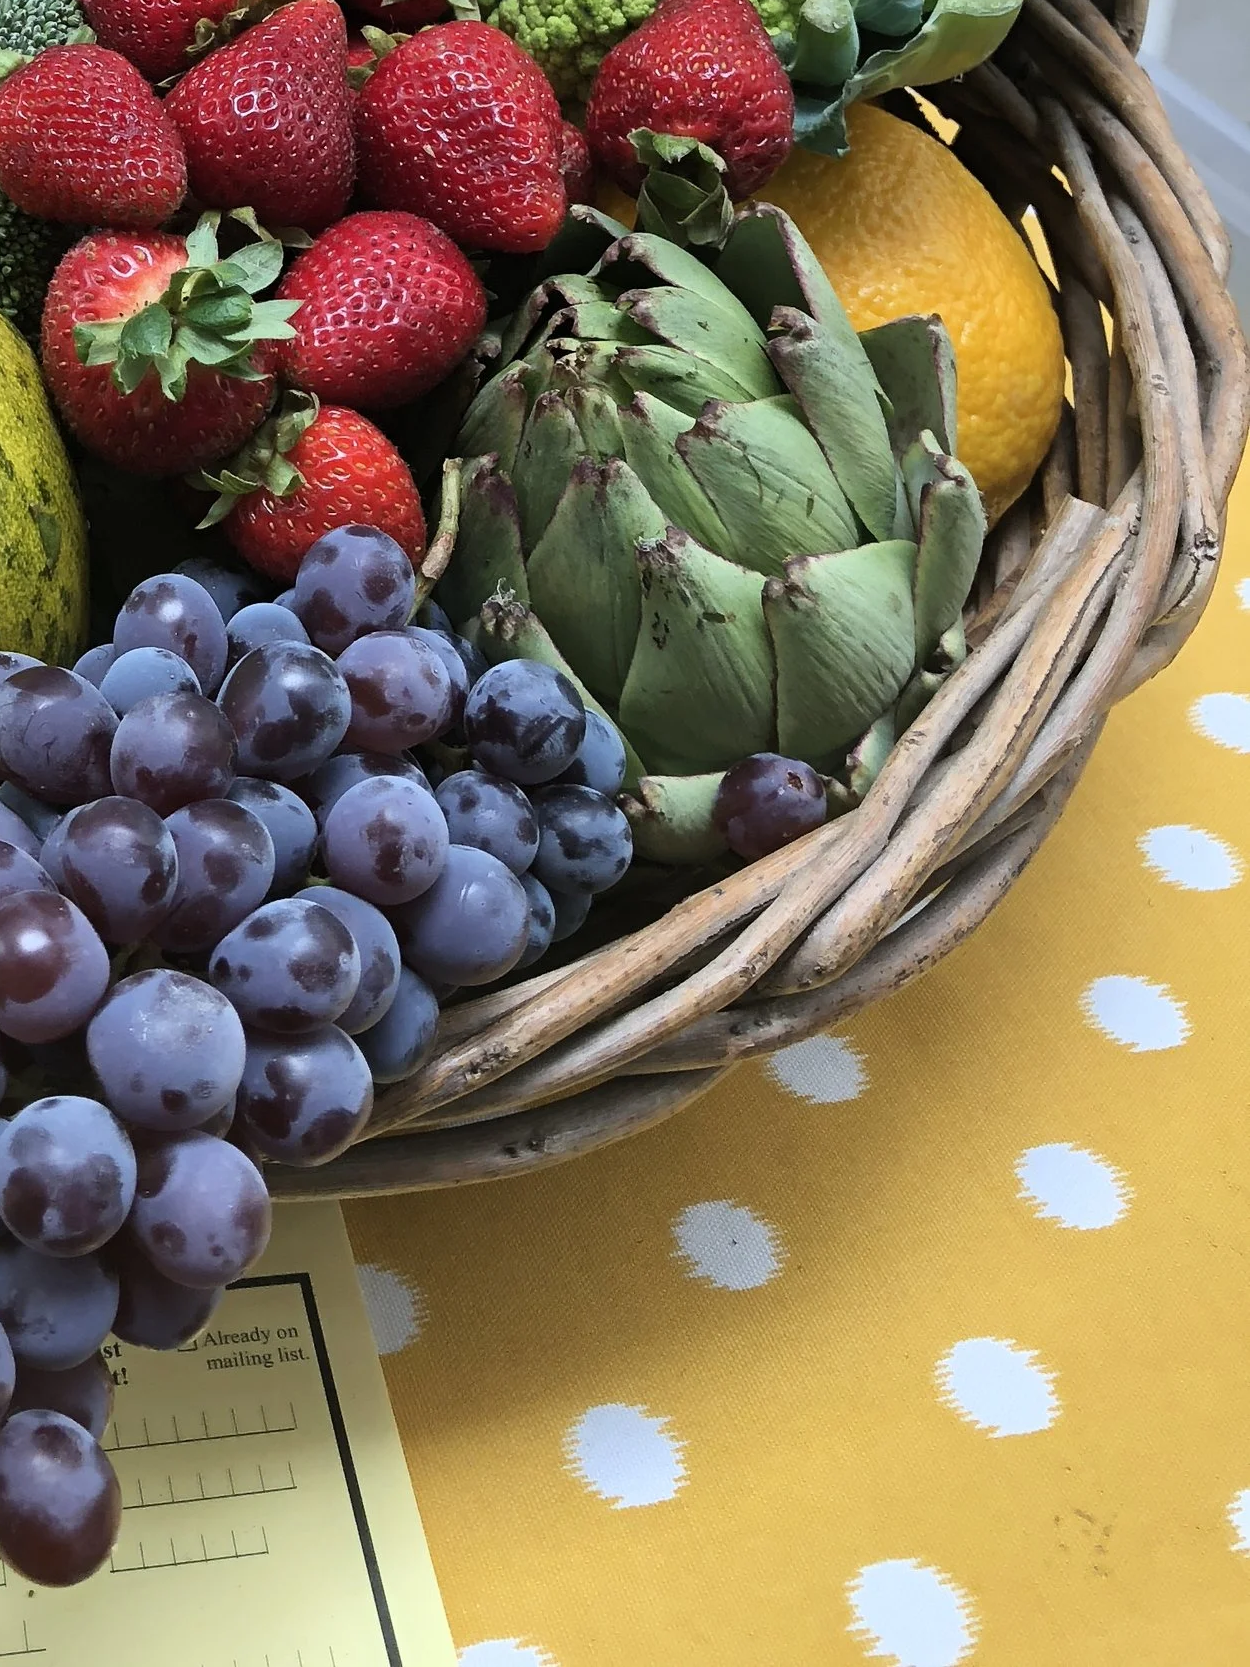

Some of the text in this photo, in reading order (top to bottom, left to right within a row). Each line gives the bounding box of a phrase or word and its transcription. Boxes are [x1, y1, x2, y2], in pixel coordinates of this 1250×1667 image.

[202, 1325, 299, 1348] Already on
[206, 1346, 310, 1371] mailing list.
